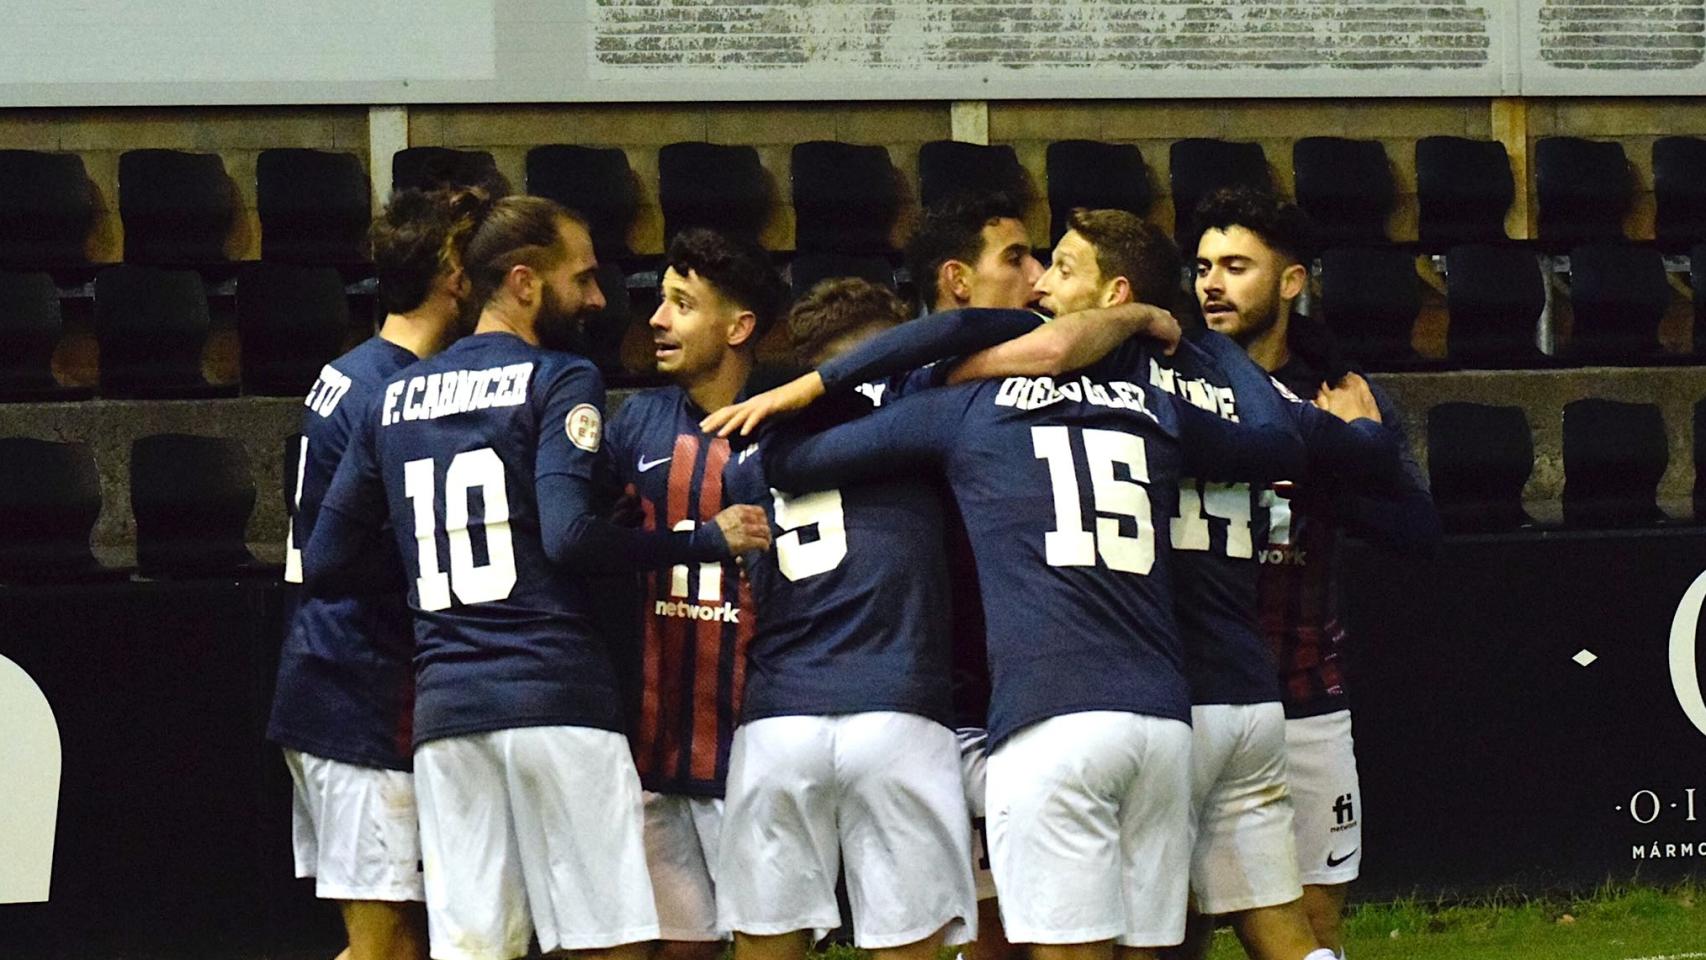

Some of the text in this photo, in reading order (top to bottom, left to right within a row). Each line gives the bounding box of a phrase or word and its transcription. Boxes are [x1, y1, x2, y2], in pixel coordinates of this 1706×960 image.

[403, 447, 517, 612] 10
[1030, 425, 1156, 575] 15
[655, 601, 741, 624] network
[1332, 793, 1353, 824] fi
